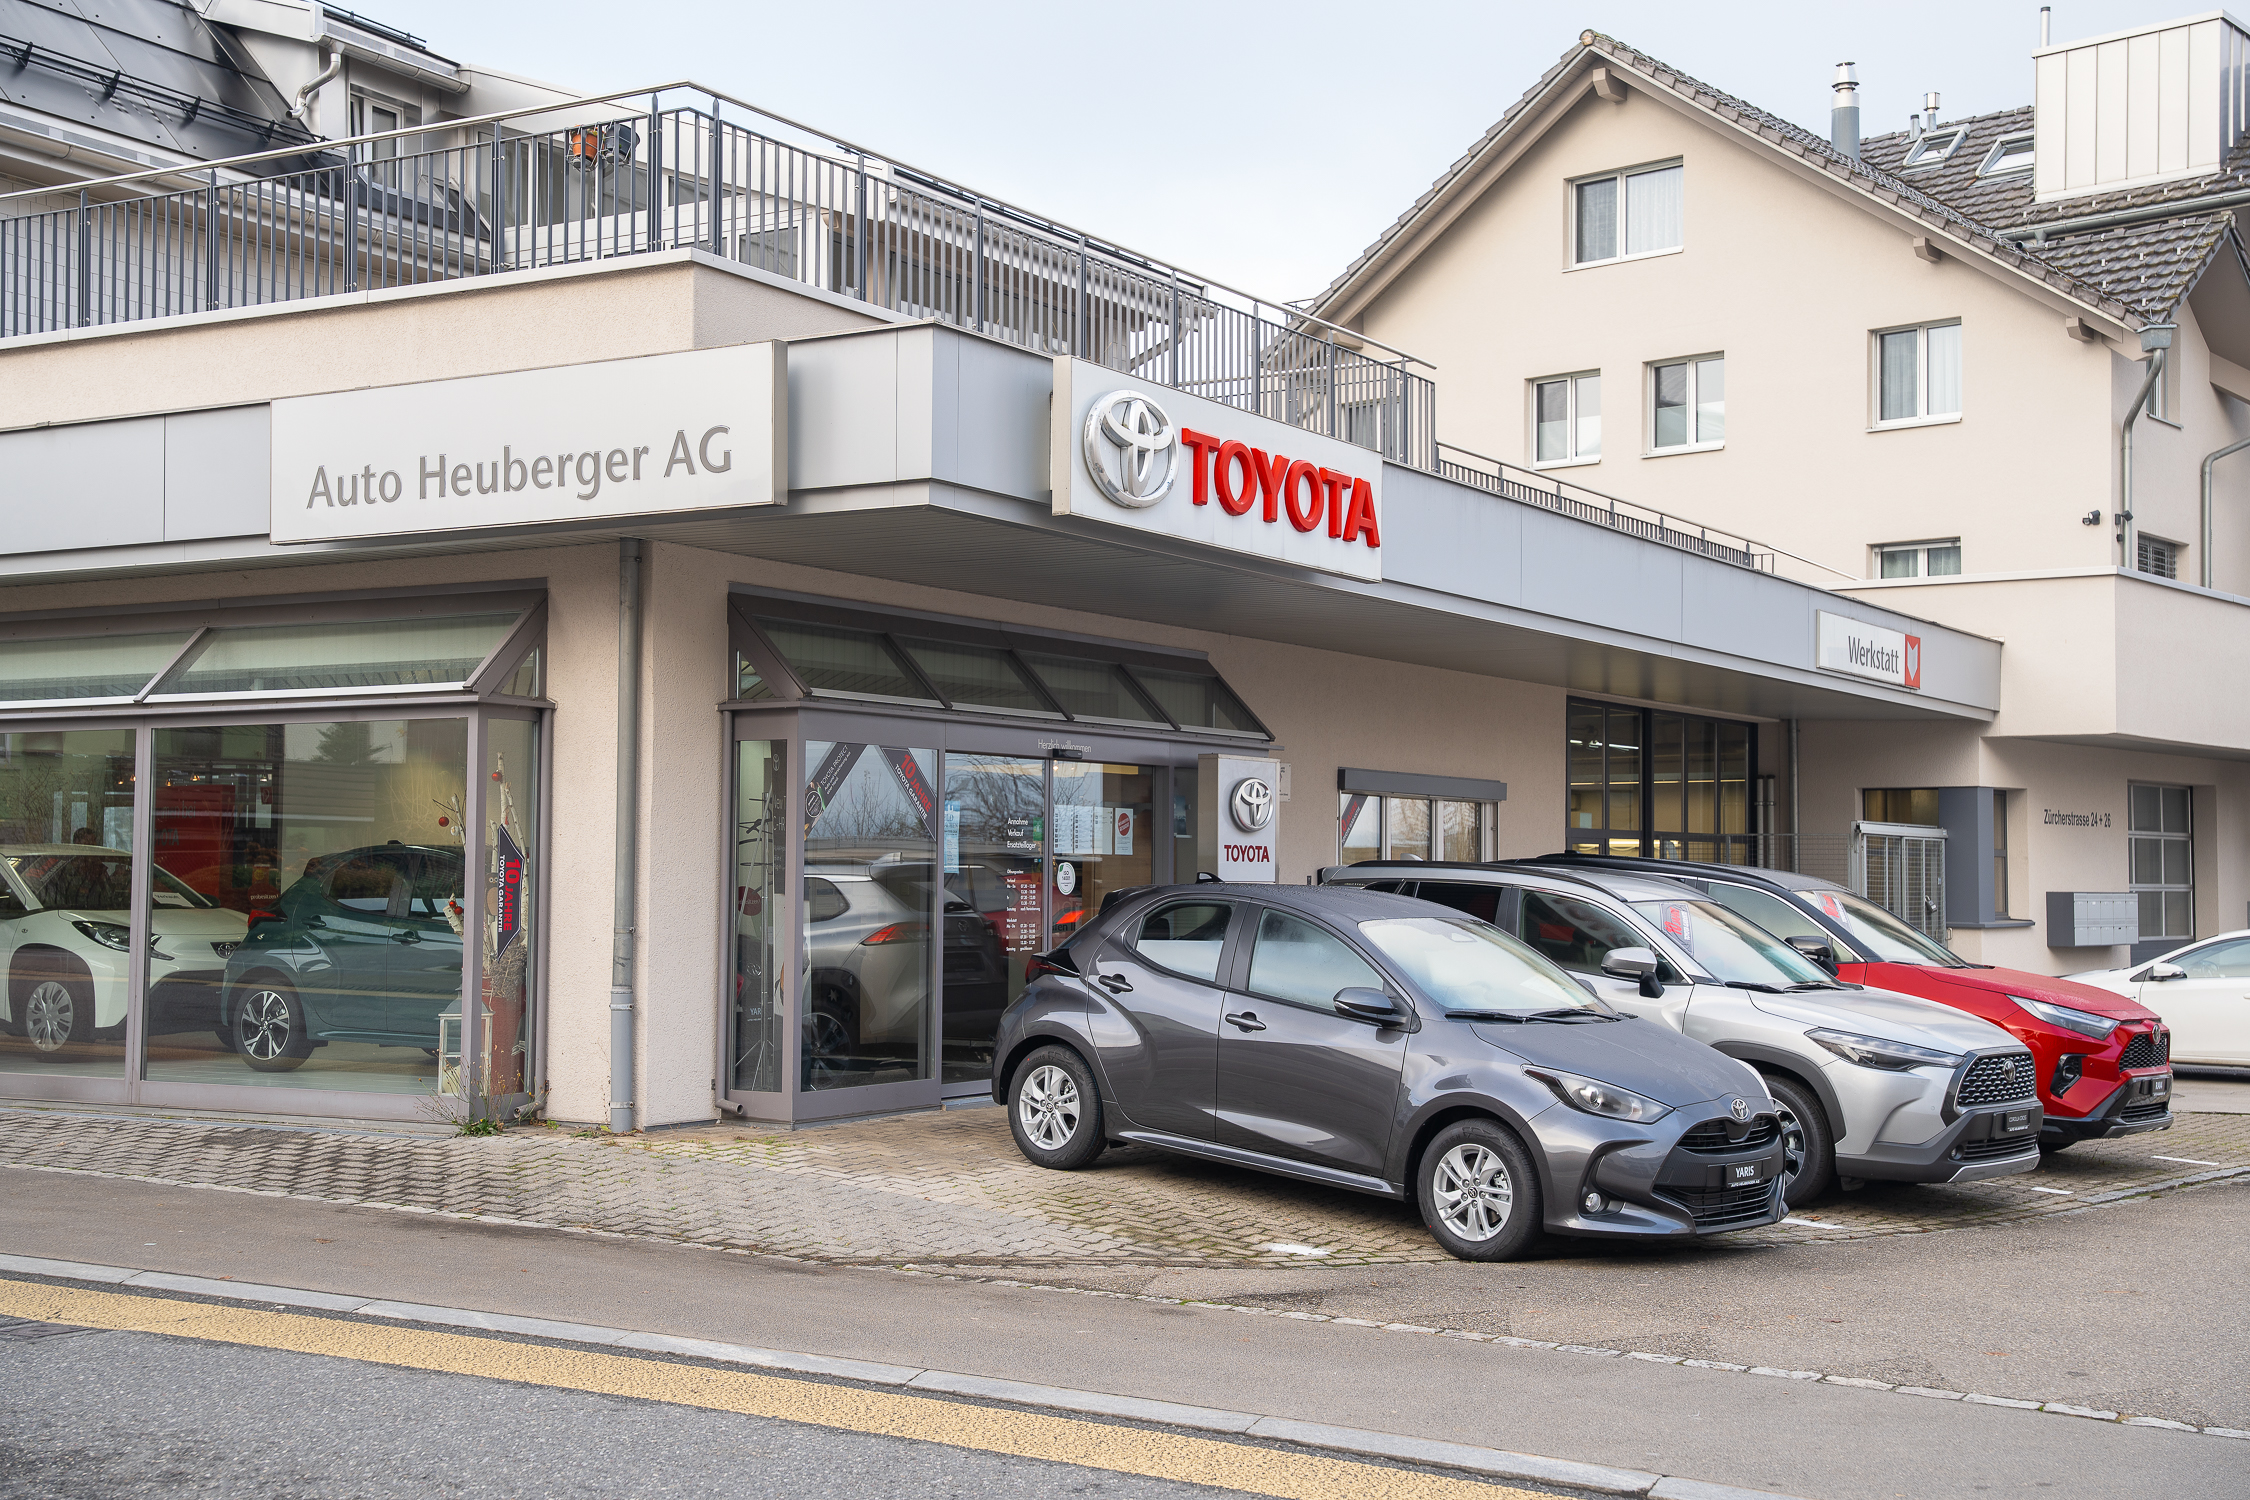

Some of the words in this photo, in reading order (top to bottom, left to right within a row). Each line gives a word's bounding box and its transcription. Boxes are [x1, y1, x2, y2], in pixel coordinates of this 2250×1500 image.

[306, 464, 403, 509] Auto
[419, 445, 650, 500] Heuberger
[663, 425, 732, 477] AG
[1181, 427, 1381, 549] TOYOTA
[1848, 635, 1900, 674] Werkstatt
[1037, 739, 1060, 750] Herzlich
[895, 764, 910, 790] TOYOTA
[908, 787, 928, 820] GARANTIE
[901, 754, 917, 779] 10
[910, 778, 932, 813] JAHRE
[1007, 817, 1028, 826] Annahme
[2043, 808, 2090, 827] Zürcherstrasse
[2090, 811, 2098, 828] 24
[2098, 815, 2103, 825] +
[2104, 812, 2112, 828] 26
[1007, 829, 1024, 837] Verkauf
[1006, 840, 1036, 851] Ersatzteillager
[1223, 844, 1270, 863] TOYOTA
[505, 858, 521, 884] 10
[503, 885, 513, 931] JAHRE
[1664, 920, 1682, 936] 10
[1735, 1165, 1755, 1178] YARIS
